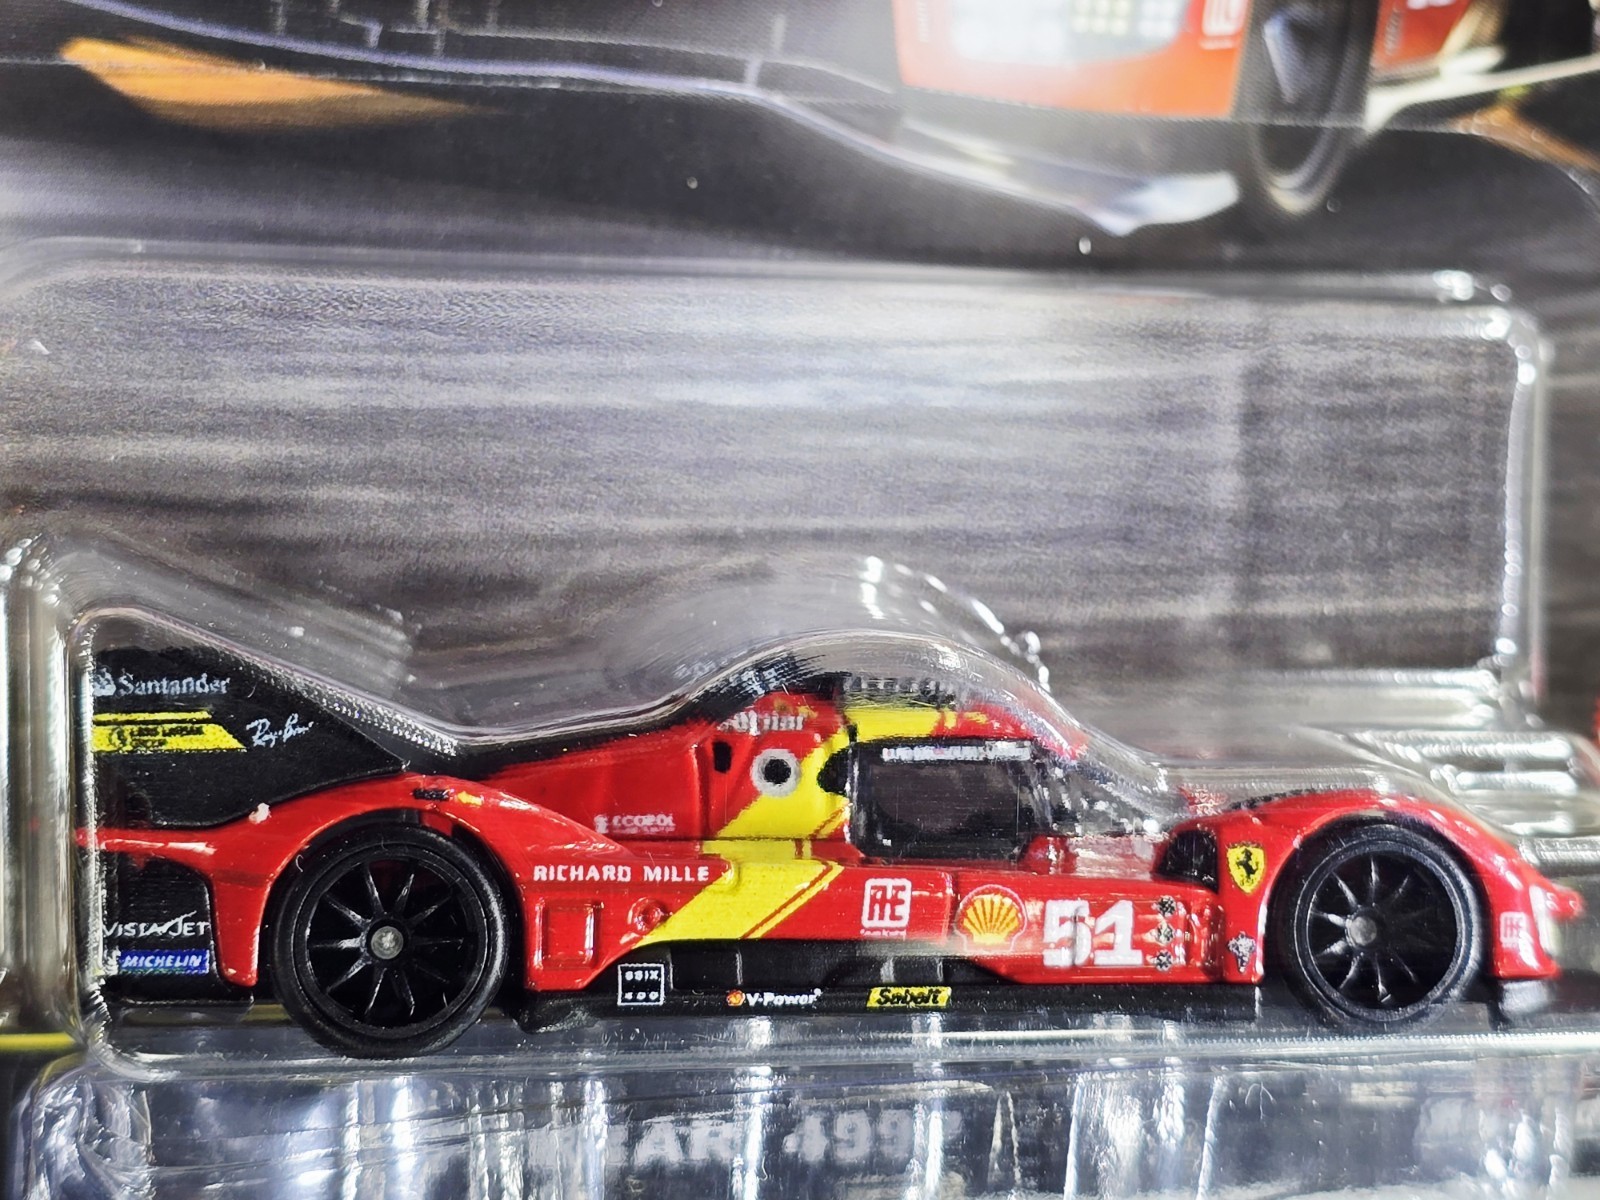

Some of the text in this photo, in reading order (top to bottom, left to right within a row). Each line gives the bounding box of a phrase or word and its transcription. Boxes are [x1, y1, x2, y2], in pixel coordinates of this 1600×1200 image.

[118, 672, 231, 697] Santander
[533, 864, 710, 882] RICHARD MILLE
[1043, 899, 1143, 968] 51
[121, 954, 203, 968] MICHELIN
[746, 992, 818, 1007] V-Power
